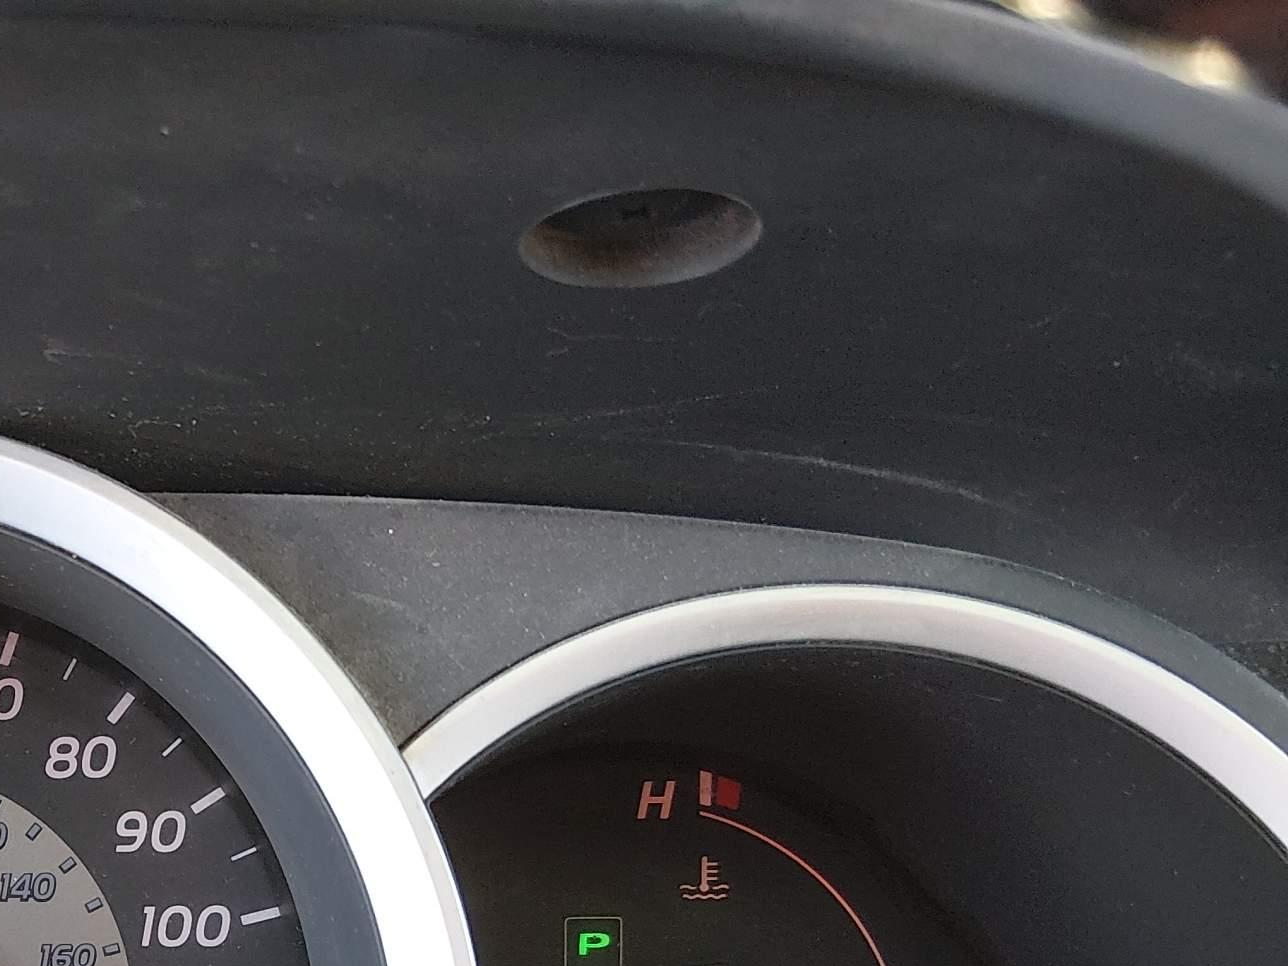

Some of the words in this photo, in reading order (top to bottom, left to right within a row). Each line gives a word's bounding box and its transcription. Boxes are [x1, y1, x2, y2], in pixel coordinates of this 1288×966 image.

[45, 735, 117, 779] 80
[636, 780, 677, 820] H
[114, 810, 187, 853] 90
[0, 872, 57, 902] 140
[140, 904, 232, 948] 100
[578, 932, 611, 956] P
